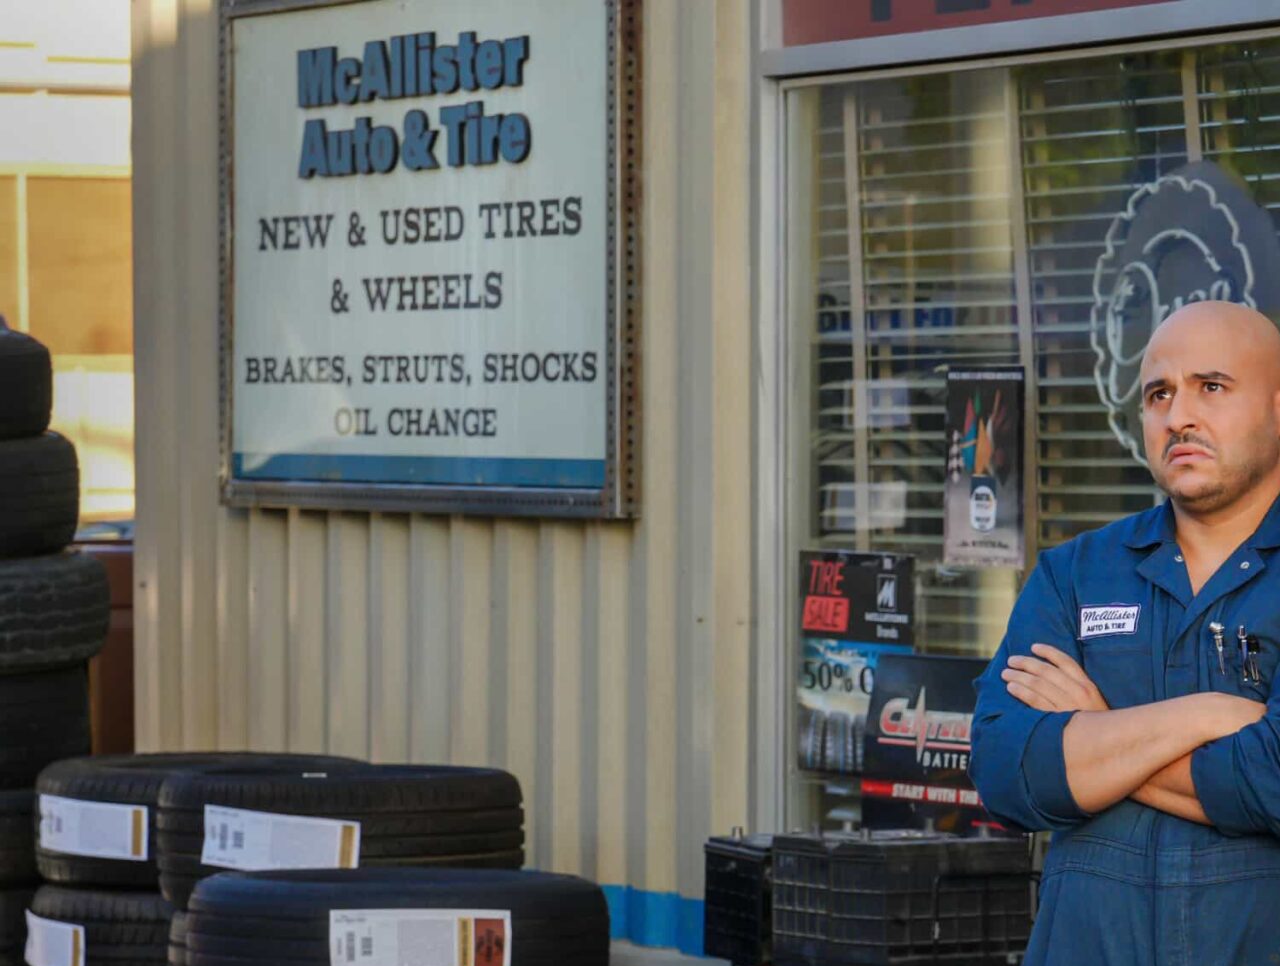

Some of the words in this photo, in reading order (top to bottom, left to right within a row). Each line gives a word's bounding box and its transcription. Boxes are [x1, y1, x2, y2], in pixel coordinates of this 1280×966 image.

[296, 31, 529, 109] McAllister
[298, 117, 399, 179] Auto
[440, 100, 532, 168] Tire
[258, 214, 334, 252] NEW
[347, 212, 367, 248] &
[380, 205, 465, 246] USED
[479, 197, 583, 240] TIRES
[330, 278, 350, 314] &
[362, 272, 504, 312] WHEELS
[245, 356, 353, 387] BRAKES,
[362, 354, 471, 387] STRUTS,
[483, 352, 598, 384] SHOCKS
[334, 407, 377, 438] OIL
[387, 408, 498, 438] CHANGE
[809, 559, 845, 595] TIRE
[808, 599, 844, 629] SALE
[1083, 610, 1136, 623] McAllister
[1087, 624, 1104, 632] AUTO
[1111, 622, 1126, 630] TIRE
[804, 661, 853, 693] 50%
[922, 750, 972, 771] BATTE
